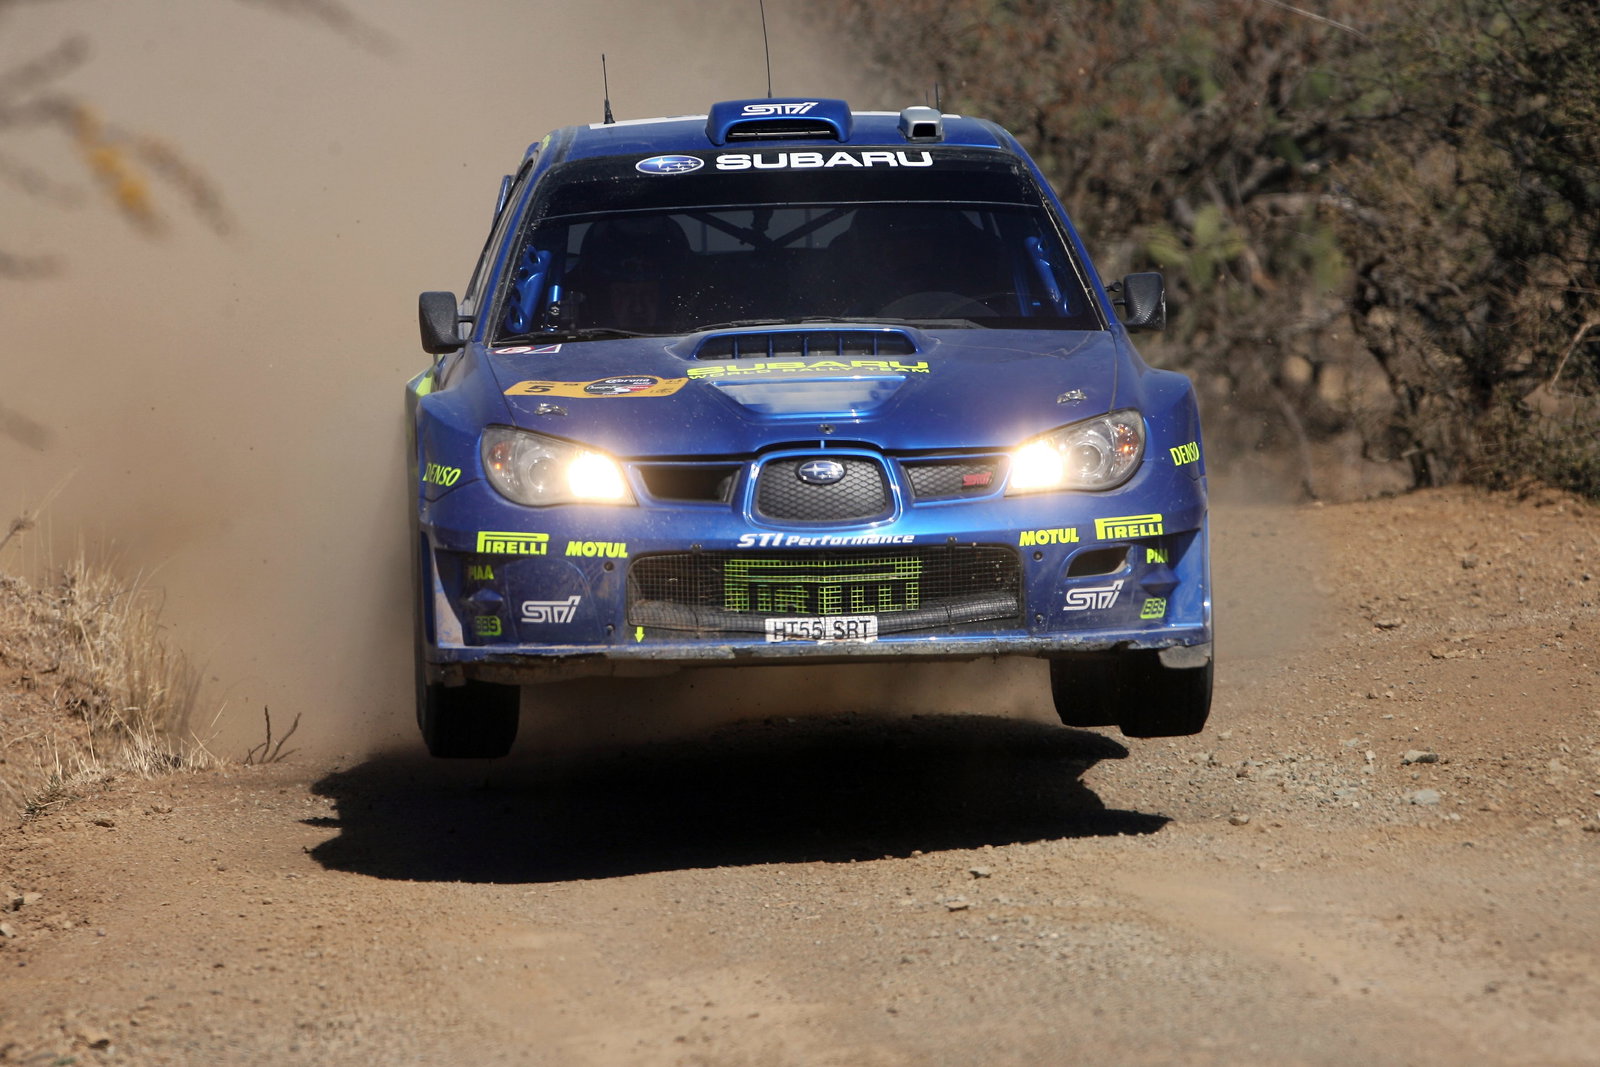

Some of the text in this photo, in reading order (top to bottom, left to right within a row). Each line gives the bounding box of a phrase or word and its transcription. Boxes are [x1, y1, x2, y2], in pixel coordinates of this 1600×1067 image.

[716, 151, 933, 170] SUBARU
[687, 360, 929, 375] SUBARU
[688, 369, 771, 380] WORLD
[865, 366, 930, 374] TEAM
[524, 385, 555, 393] 5
[1169, 442, 1200, 466] DENSO
[422, 463, 460, 486] DENSO
[1094, 514, 1163, 539] PIRELLI
[476, 531, 549, 555] PIRELLI
[737, 533, 915, 547] STI Performance
[1019, 528, 1079, 546] MOTUL
[565, 541, 628, 558] MOTUL
[724, 556, 922, 614] PIRELLI
[773, 620, 871, 640] HT55 SRT
